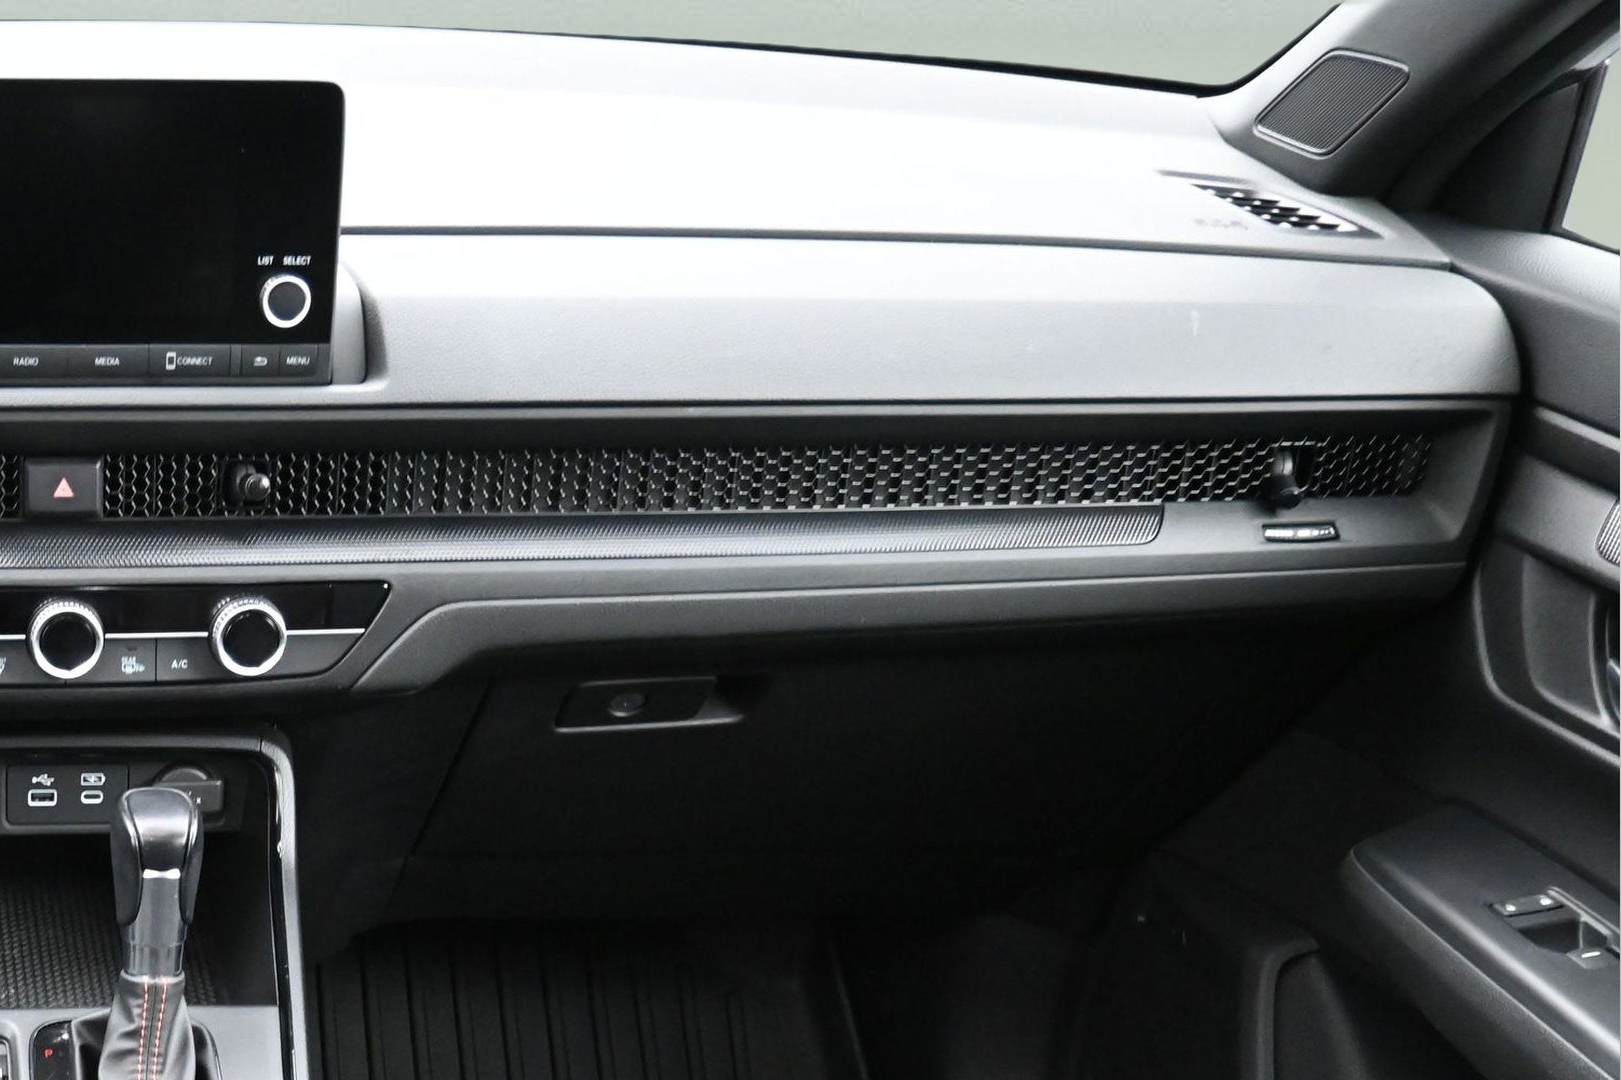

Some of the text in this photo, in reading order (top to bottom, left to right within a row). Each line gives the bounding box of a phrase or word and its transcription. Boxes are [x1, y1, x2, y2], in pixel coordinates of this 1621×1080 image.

[258, 255, 311, 266] LIST SELECT
[13, 356, 39, 367] RADIO
[94, 356, 120, 366] MEDIA
[176, 356, 213, 366] CONNECT
[286, 355, 311, 366] MENU
[171, 659, 189, 669] A/C
[44, 1049, 54, 1059] P
